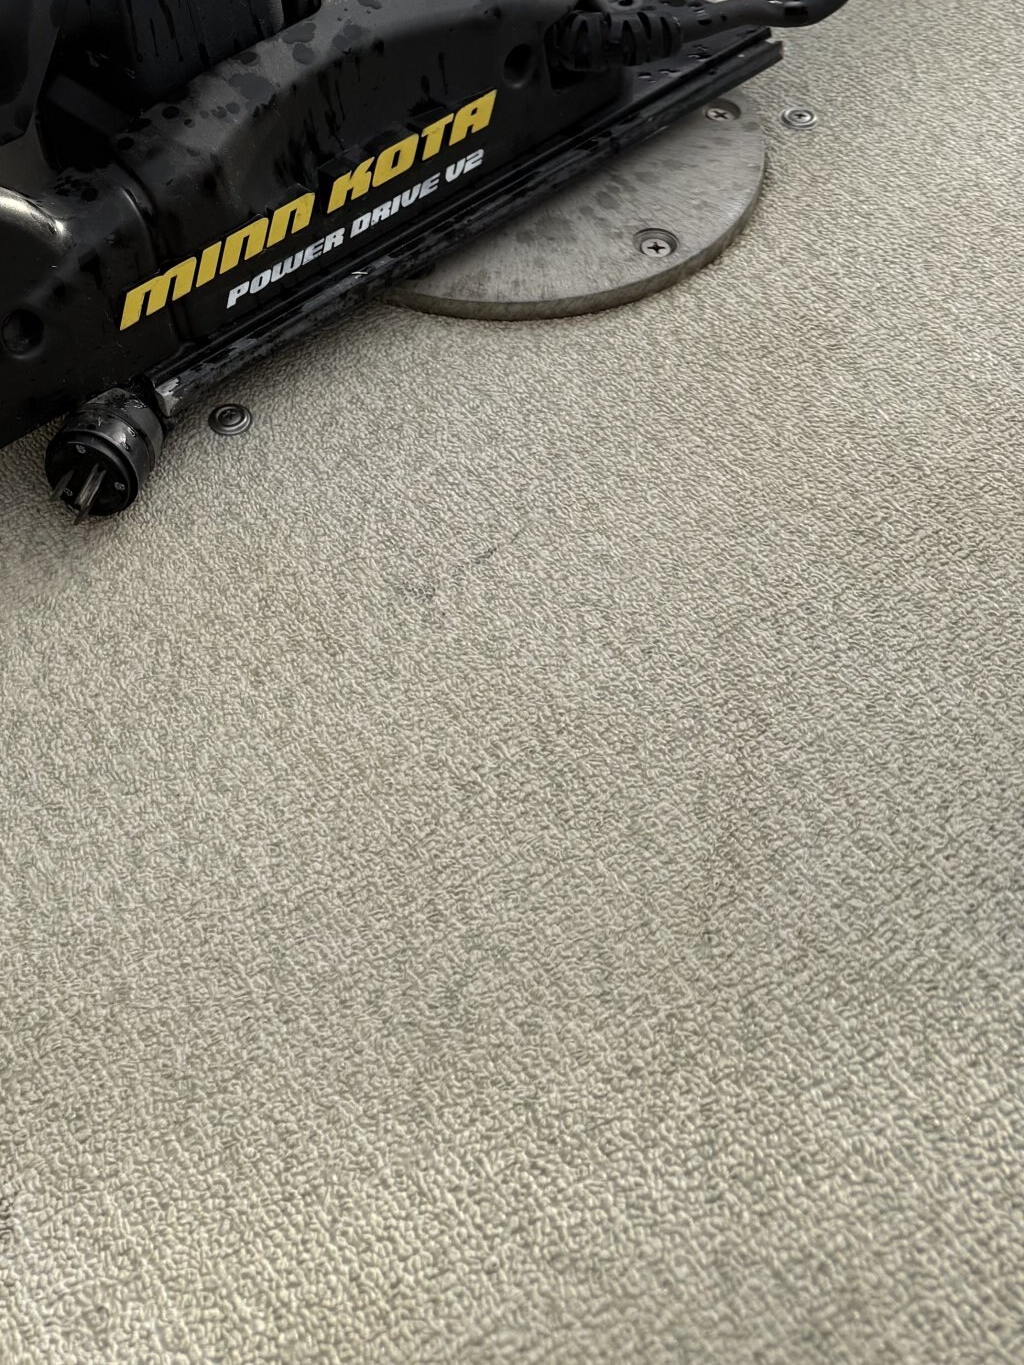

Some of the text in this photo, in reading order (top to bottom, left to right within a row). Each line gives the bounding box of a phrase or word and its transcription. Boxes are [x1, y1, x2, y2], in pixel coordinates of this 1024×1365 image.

[119, 89, 498, 331] MINN KOTA
[226, 148, 486, 309] POWER DRIVE V2
